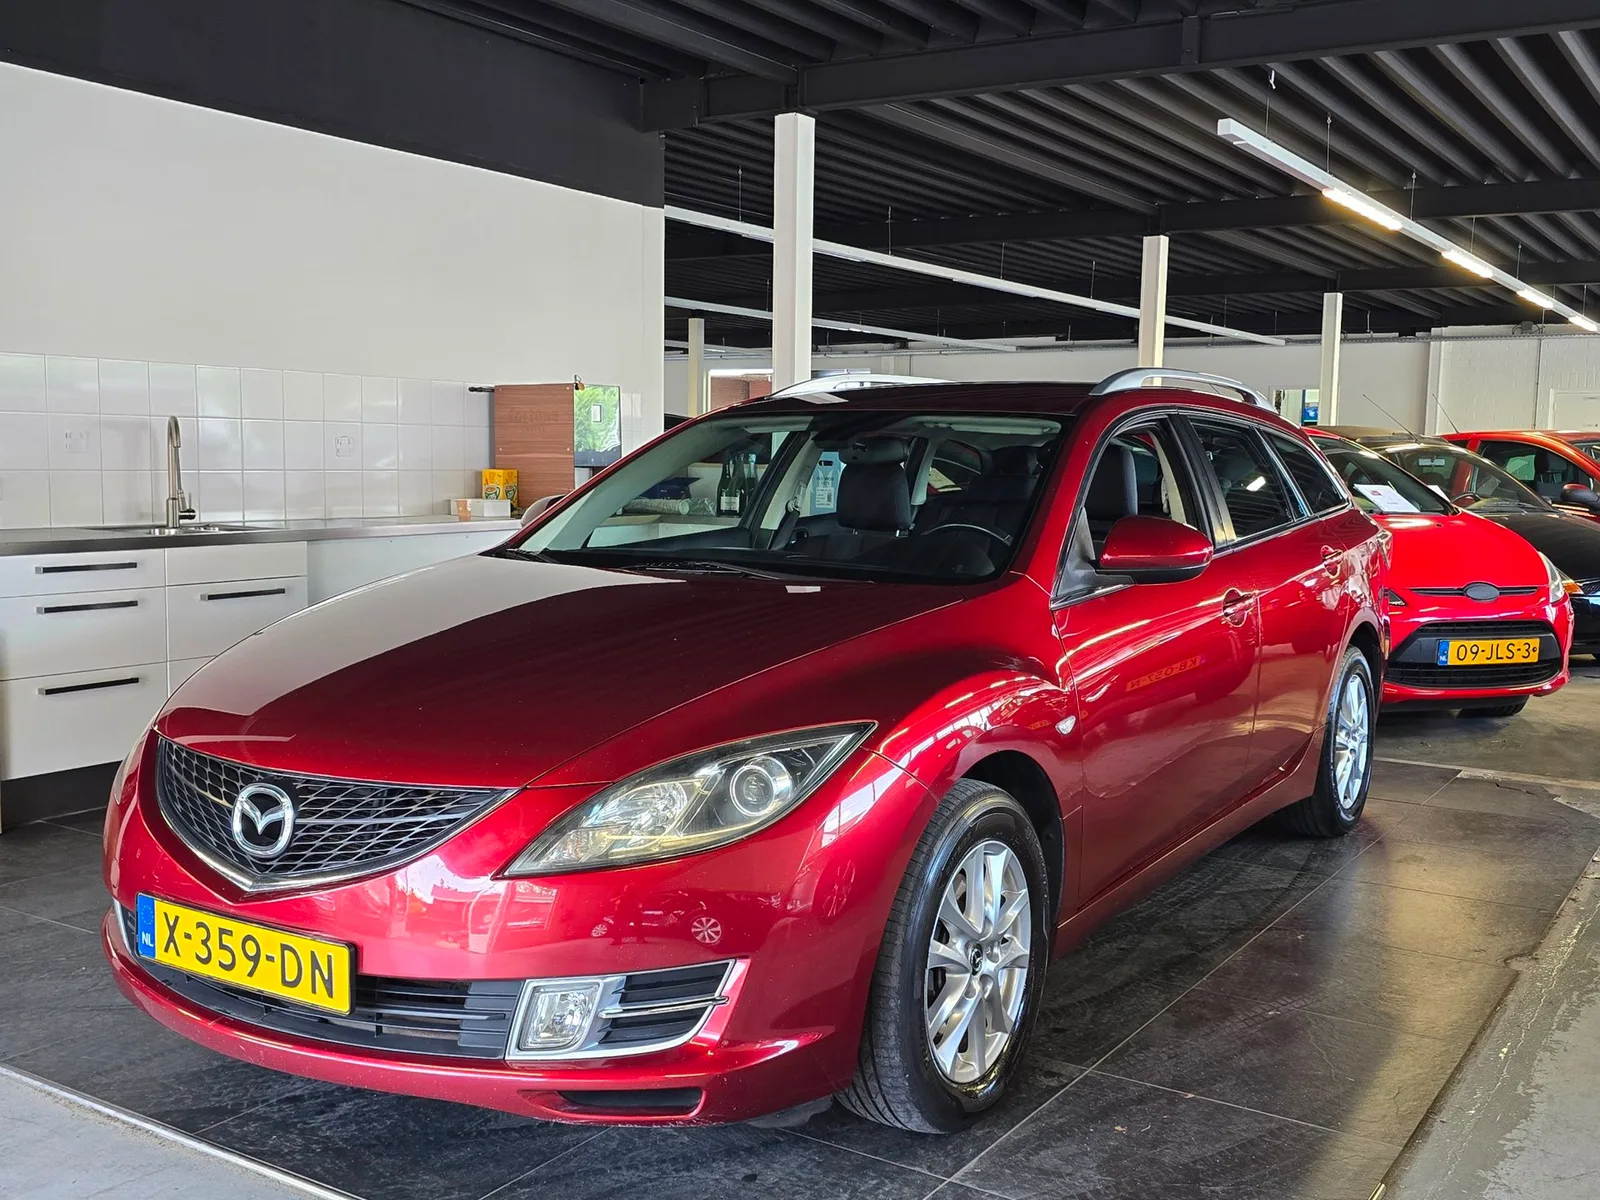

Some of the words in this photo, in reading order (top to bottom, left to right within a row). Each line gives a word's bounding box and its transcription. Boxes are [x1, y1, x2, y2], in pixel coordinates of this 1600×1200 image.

[1457, 643, 1531, 662] 09-JLS-3
[141, 933, 154, 947] NL
[163, 911, 334, 999] X-359-DN
